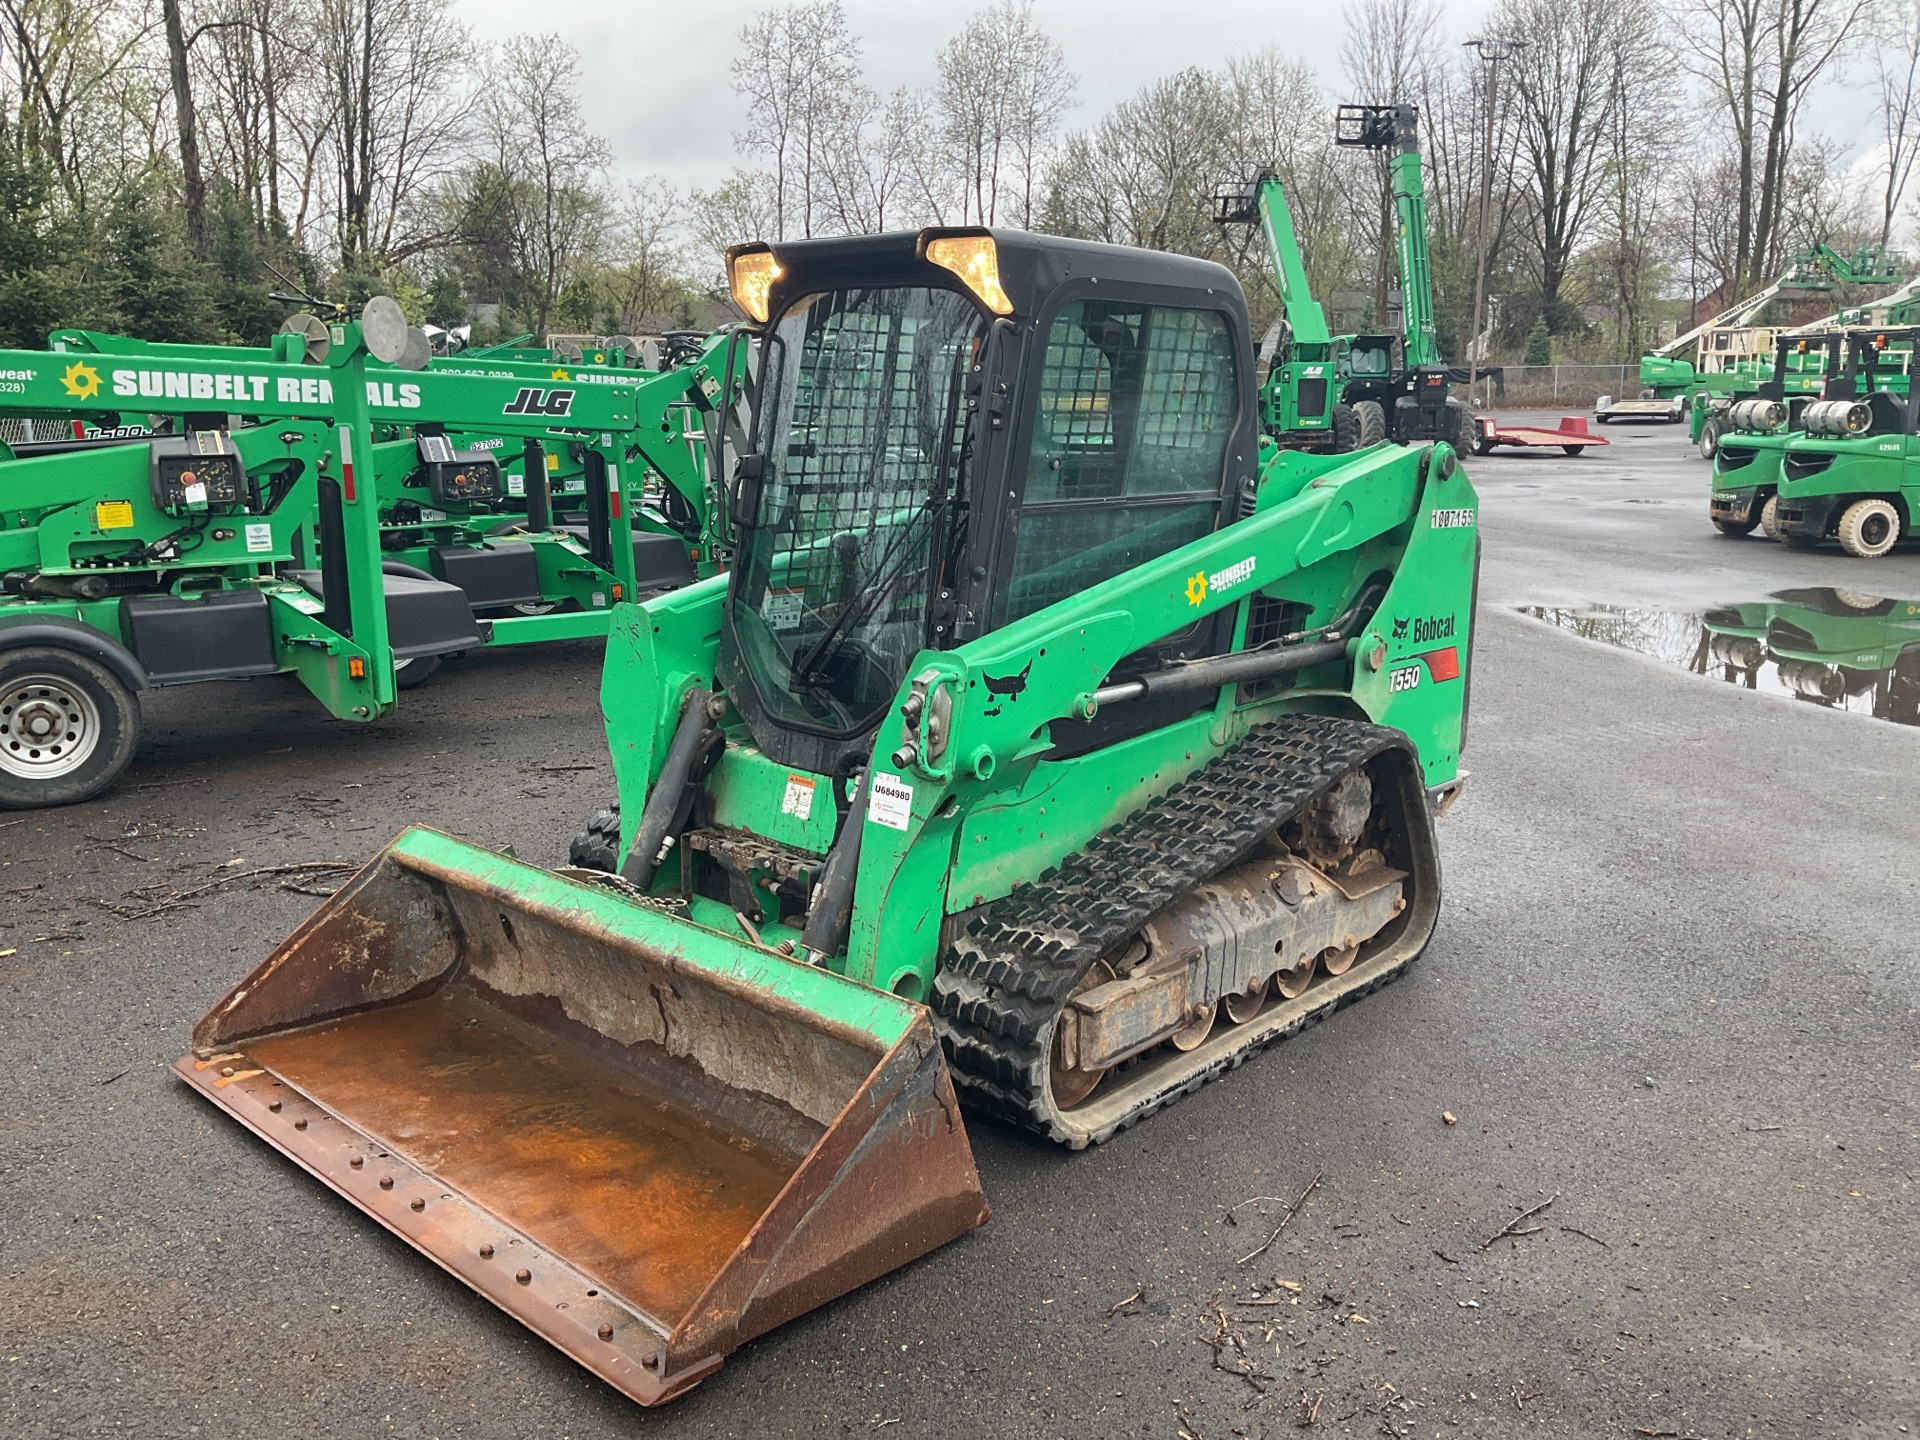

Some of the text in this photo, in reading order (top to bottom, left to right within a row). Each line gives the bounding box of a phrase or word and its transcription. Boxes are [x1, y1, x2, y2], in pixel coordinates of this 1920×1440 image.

[112, 370, 421, 408] SUNBELT RENALS
[502, 387, 576, 417] JLG
[471, 438, 503, 450] 827022
[1432, 509, 1473, 528] 1007155
[1209, 555, 1256, 590] SUNBELT
[1216, 572, 1251, 594] RENTALS
[1413, 612, 1455, 644] Bobcat
[1389, 664, 1421, 693] T550
[875, 784, 911, 801] U684980
